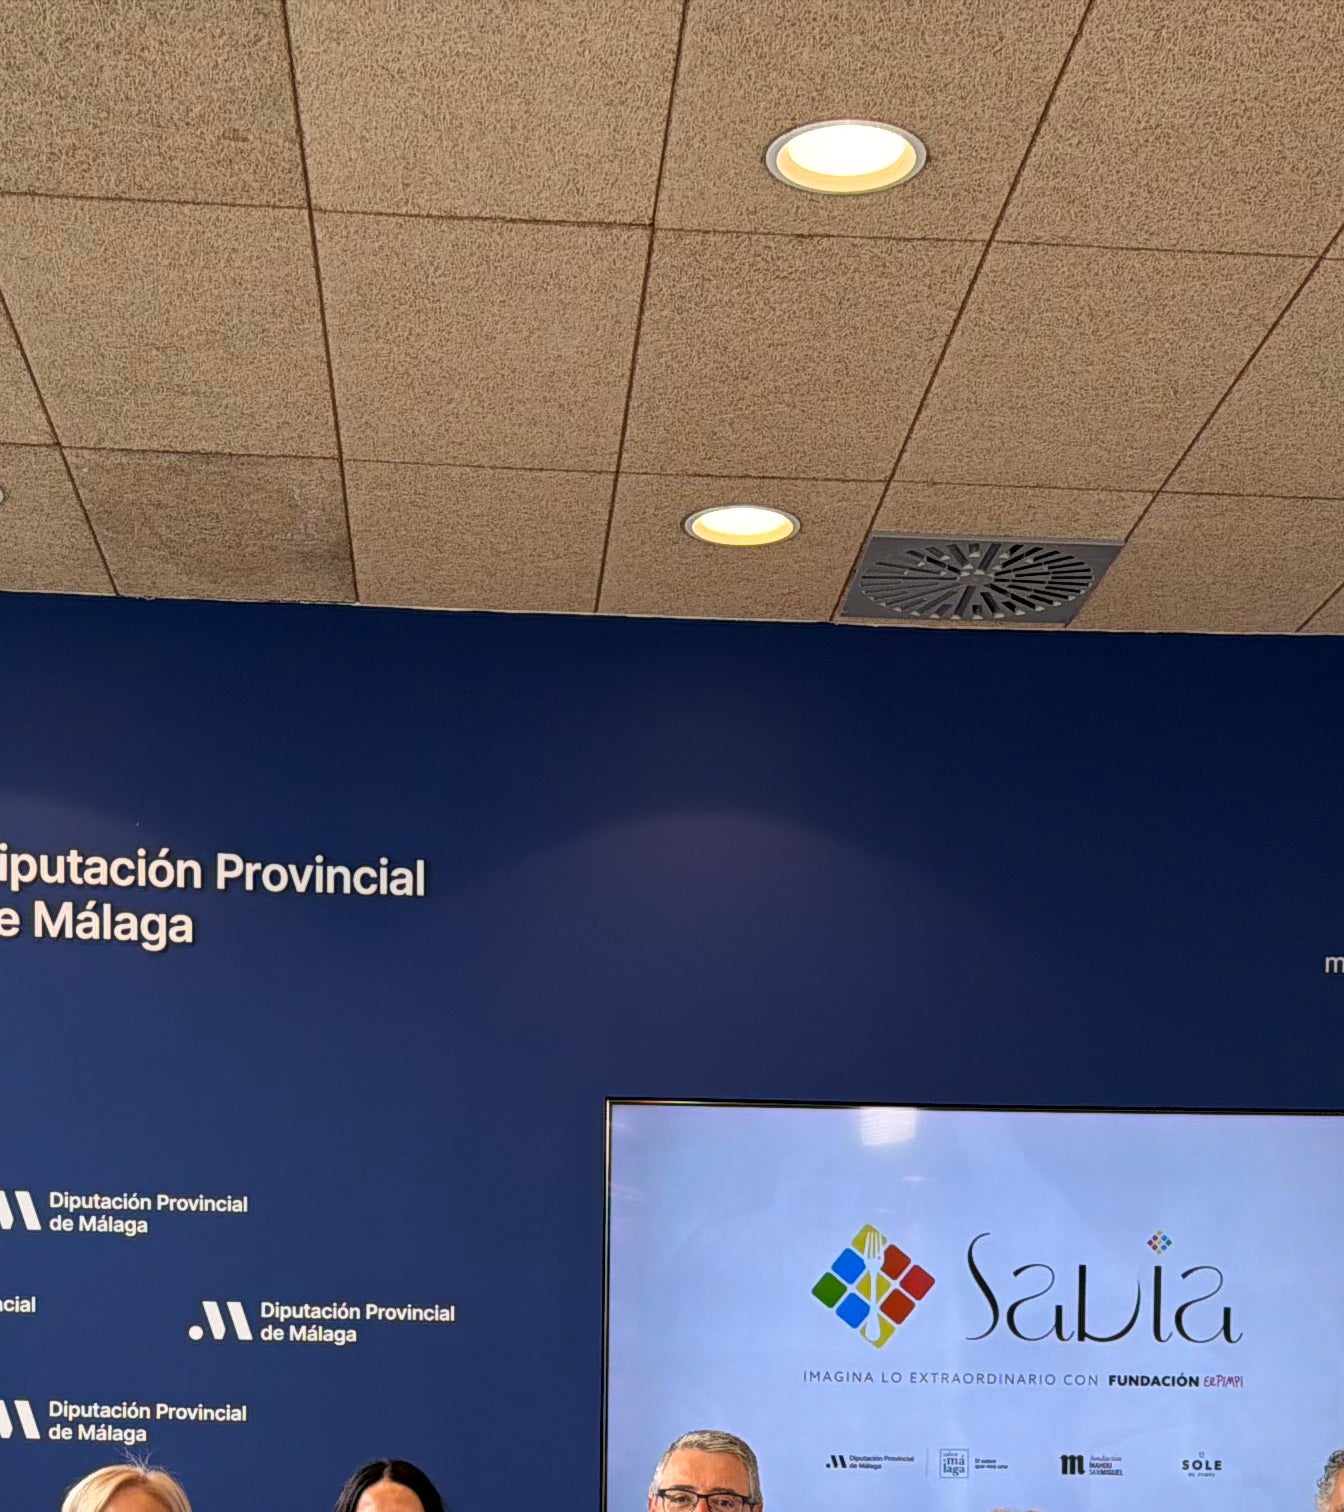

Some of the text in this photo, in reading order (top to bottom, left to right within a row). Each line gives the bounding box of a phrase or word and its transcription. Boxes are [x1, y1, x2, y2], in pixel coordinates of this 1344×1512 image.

[216, 853, 425, 896] Provincial
[34, 900, 194, 951] Málaga
[49, 1191, 248, 1213] Diputación Provincial
[49, 1214, 148, 1237] de Málaga
[966, 1231, 1243, 1343] Savia
[260, 1301, 455, 1322] Diputación Provincial
[260, 1324, 357, 1346] de Málaga
[803, 1371, 874, 1383] IMAGINA
[881, 1372, 902, 1384] LO
[910, 1372, 1056, 1385] EXTRAORDINARIO
[1063, 1374, 1098, 1386] CON
[1108, 1372, 1199, 1387] FUNDACIÓN
[48, 1400, 247, 1421] Diputación Provincial
[48, 1423, 147, 1445] de Málaga
[1182, 1460, 1222, 1470] SOLE
